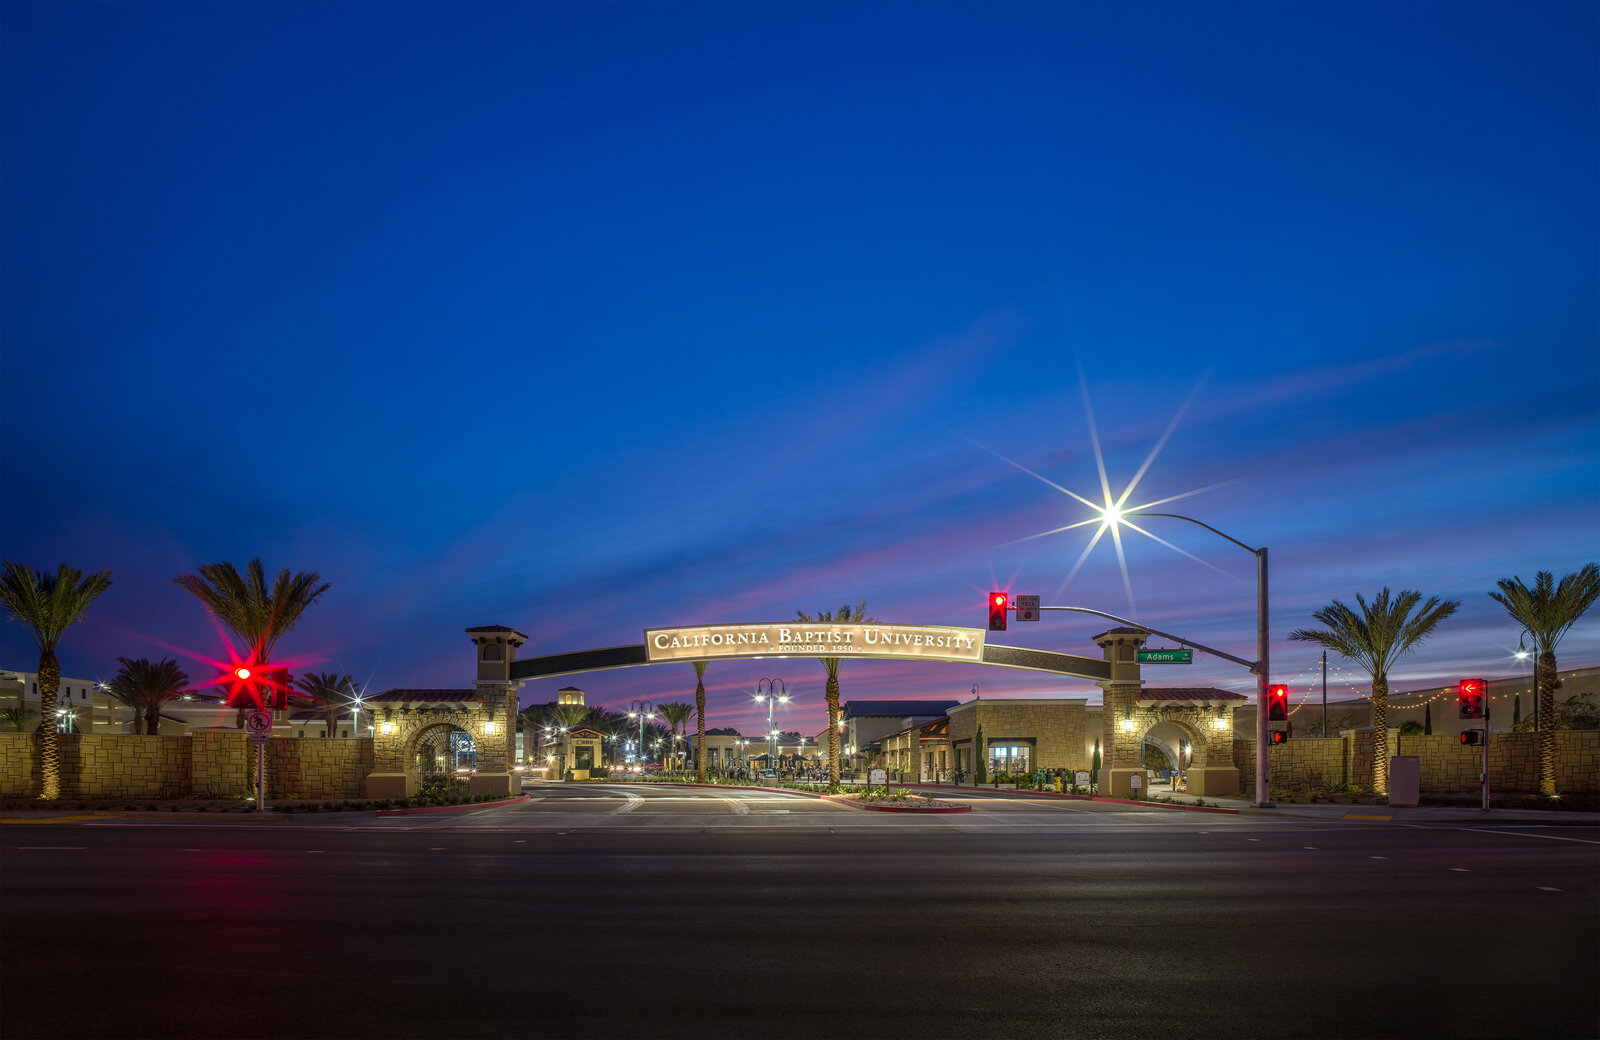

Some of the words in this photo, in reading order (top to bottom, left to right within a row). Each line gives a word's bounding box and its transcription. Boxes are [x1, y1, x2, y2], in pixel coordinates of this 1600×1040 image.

[654, 633, 769, 649] CALIFORNIA
[778, 628, 854, 643] BAPTIST
[864, 628, 974, 649] UNIVERSITY
